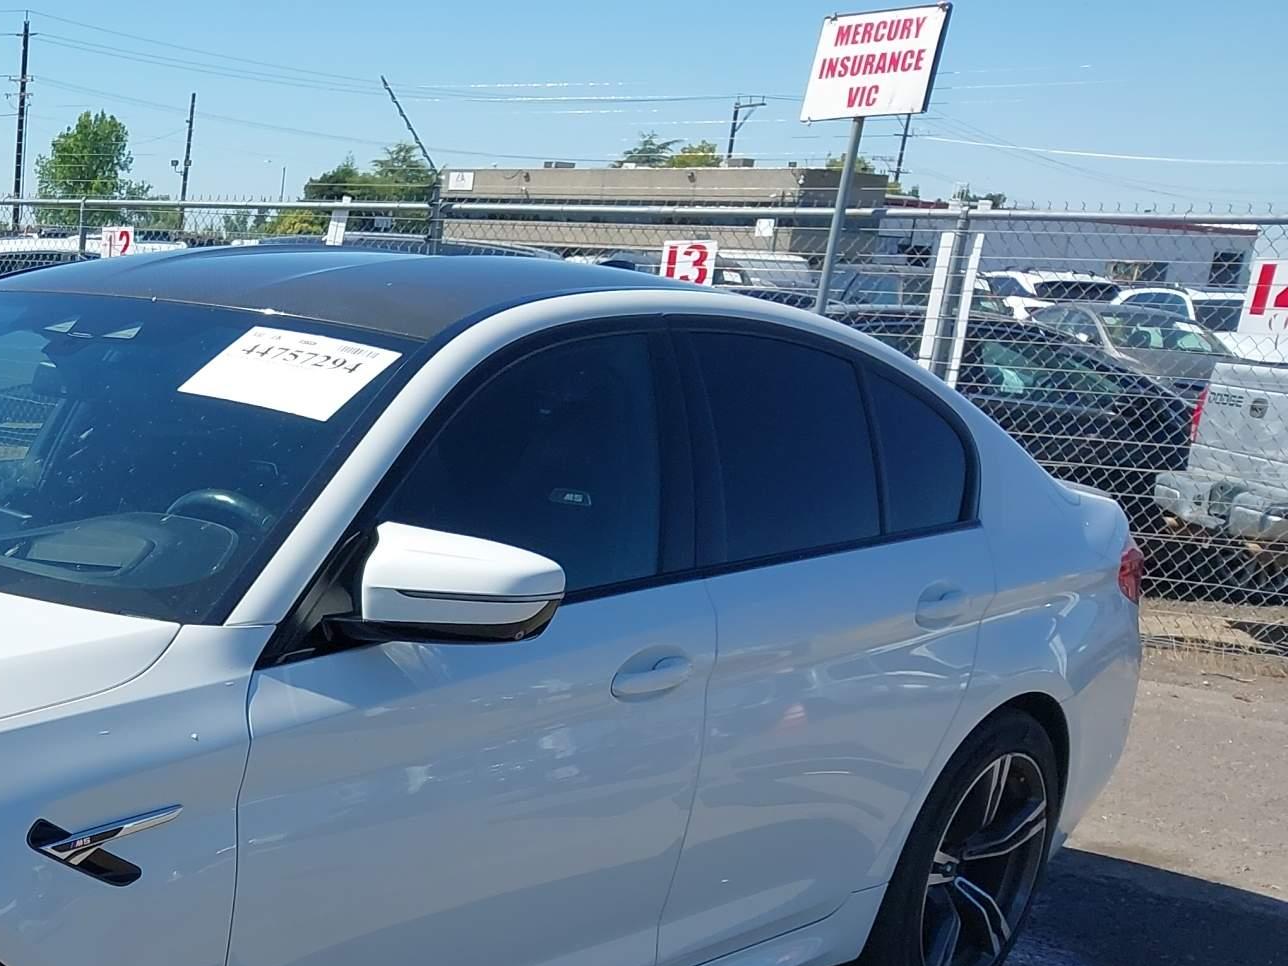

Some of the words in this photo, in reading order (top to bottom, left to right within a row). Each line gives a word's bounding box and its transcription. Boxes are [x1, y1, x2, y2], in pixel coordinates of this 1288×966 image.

[834, 16, 928, 47] MERCURY
[818, 49, 926, 80] INSURANCE
[846, 85, 879, 108] VIC
[665, 244, 708, 284] 13
[242, 343, 364, 374] 44757294
